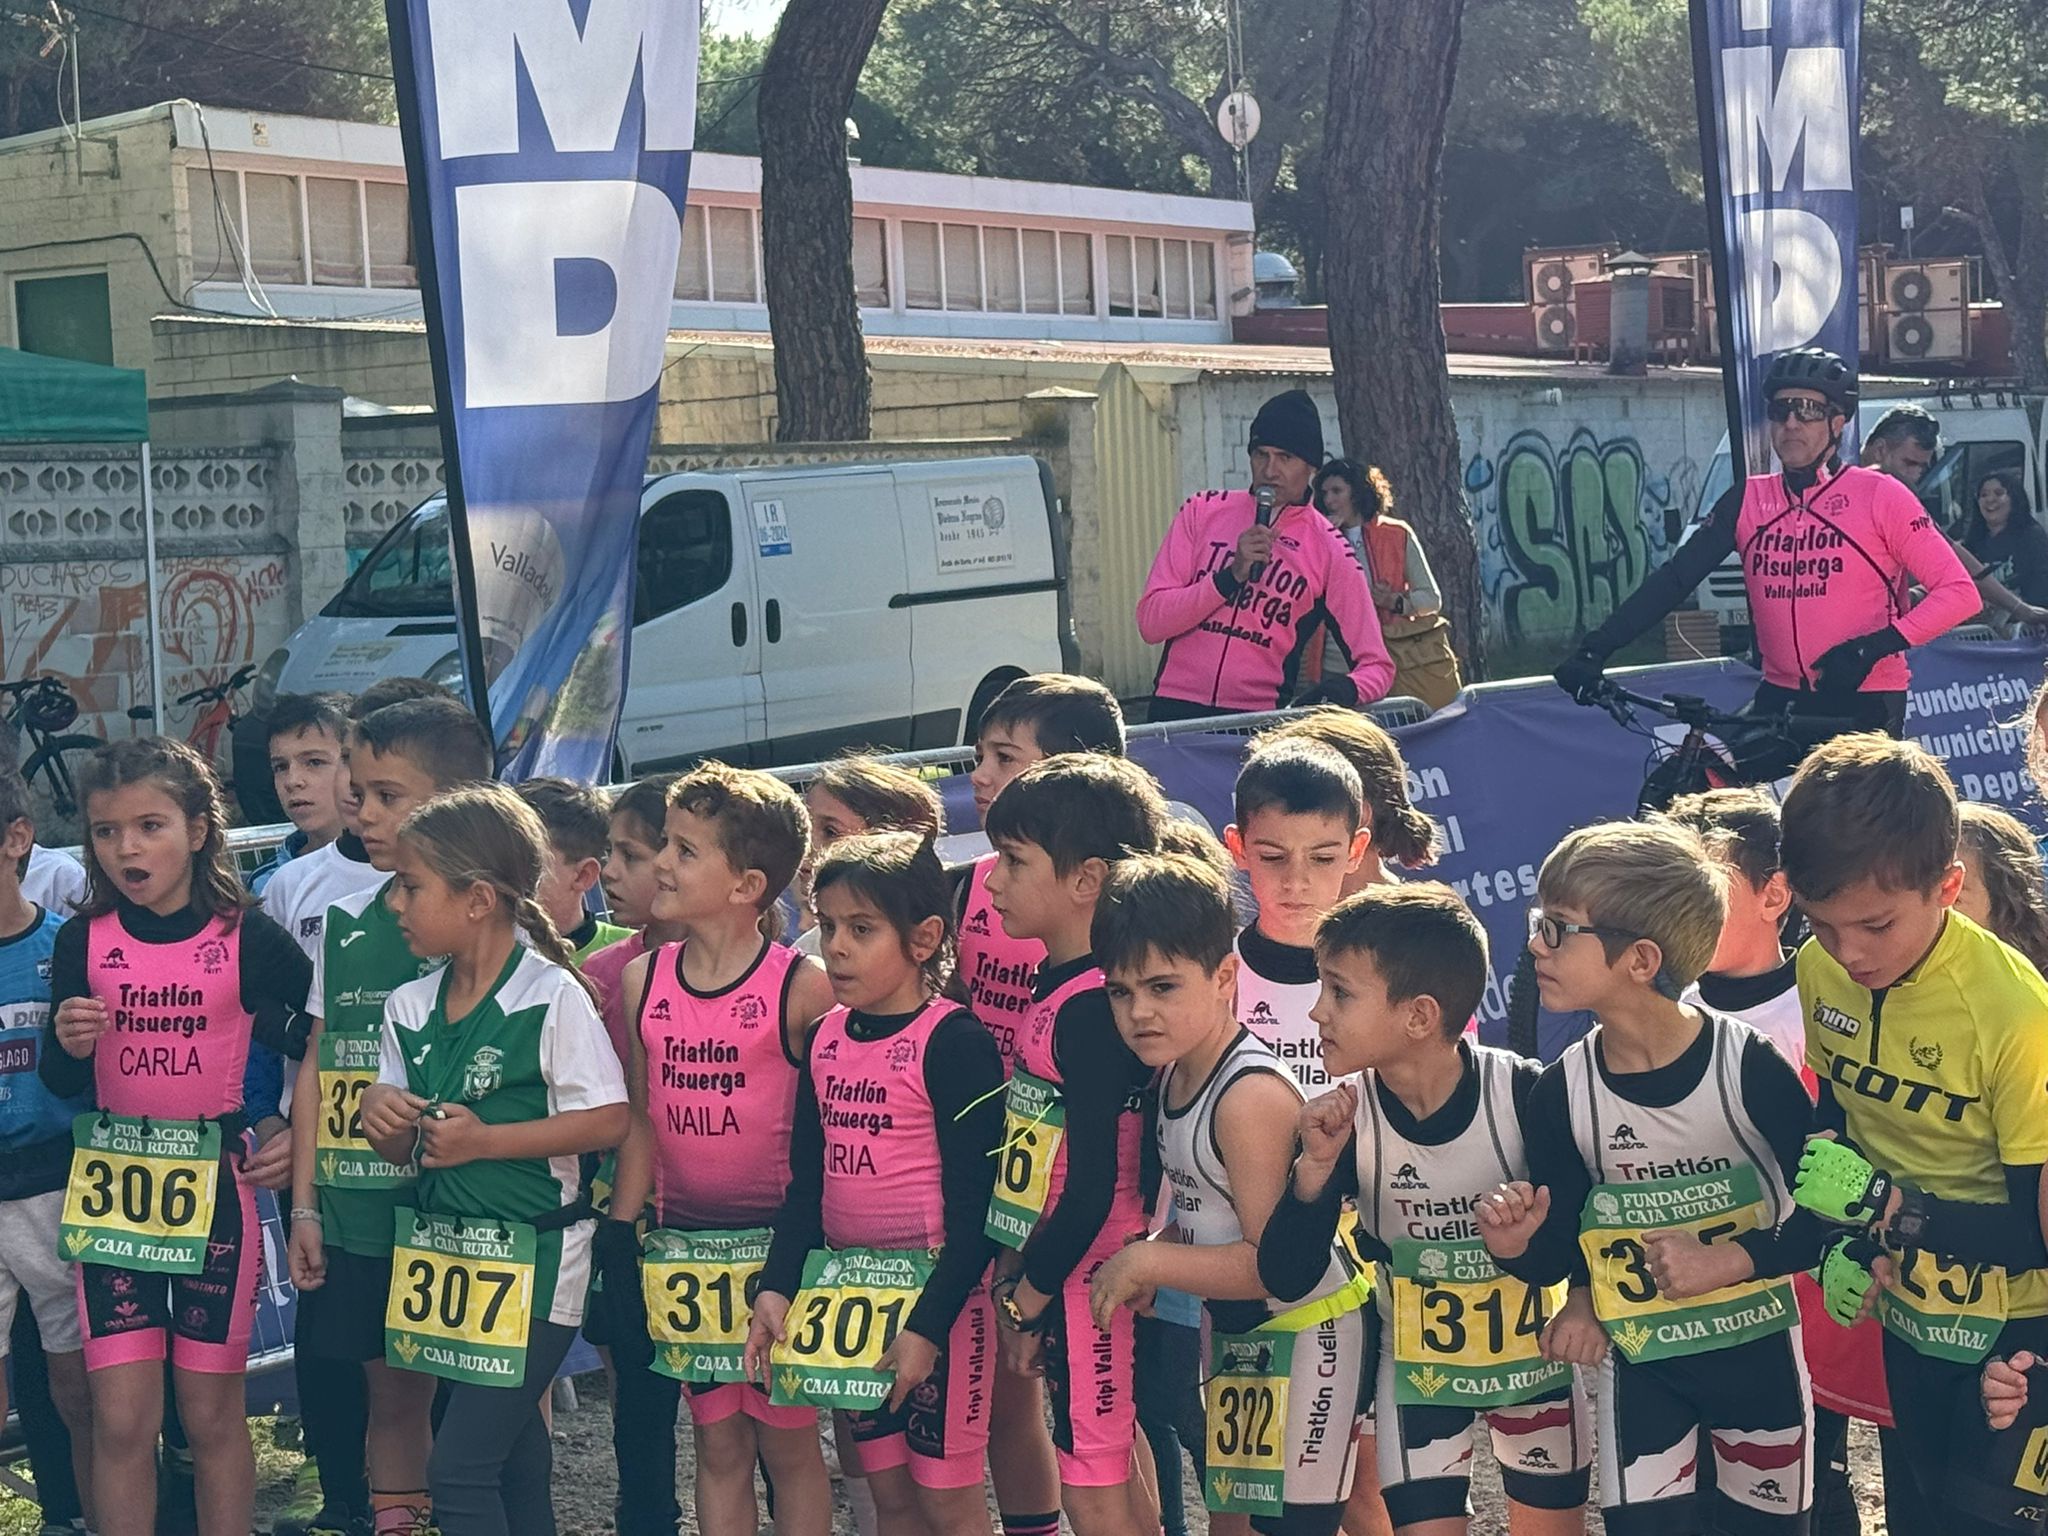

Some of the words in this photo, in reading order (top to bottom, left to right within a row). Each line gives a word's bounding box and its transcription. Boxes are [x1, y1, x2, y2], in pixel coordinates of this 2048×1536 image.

[1905, 673, 2030, 720] Fundación
[119, 983, 203, 1008] Triatlón
[115, 1010, 207, 1038] Pisuerga
[119, 1046, 202, 1077] CARLA
[663, 1036, 739, 1063] Triatlón
[661, 1063, 746, 1097] Pisuerga
[825, 1074, 887, 1104] Triatlón
[666, 1103, 741, 1137] NAILA
[820, 1102, 894, 1137] Pisuerga
[113, 1138, 144, 1153] CAJA
[147, 1142, 198, 1157] RURAL
[828, 1142, 877, 1176] IRIA
[1616, 1155, 1732, 1181] Triatlón
[81, 1160, 197, 1227] 306
[1621, 1179, 1733, 1209] FUNDACION
[1626, 1208, 1669, 1225] CAJA
[1670, 1195, 1737, 1220] RURAL
[94, 1238, 133, 1256] CAJA
[137, 1244, 196, 1263] RURAL
[462, 1241, 514, 1259] RURAL
[865, 1271, 915, 1287] RURAL
[1454, 1264, 1498, 1280] CAJA
[403, 1259, 517, 1333] 307
[792, 1296, 905, 1358] 301
[1423, 1283, 1550, 1354] 314
[1657, 1320, 1711, 1343] CAJA
[1712, 1302, 1786, 1334] RURAL
[1890, 1308, 1923, 1341] CAJA
[1926, 1326, 1989, 1350] RURAL
[424, 1347, 456, 1366] CAJA
[458, 1353, 515, 1375] RURAL
[968, 1307, 986, 1385] Valladolid
[803, 1378, 841, 1395] CAJA
[1452, 1377, 1503, 1395] CAJA
[1216, 1386, 1274, 1457] 322
[1298, 1386, 1333, 1468] Triatlón
